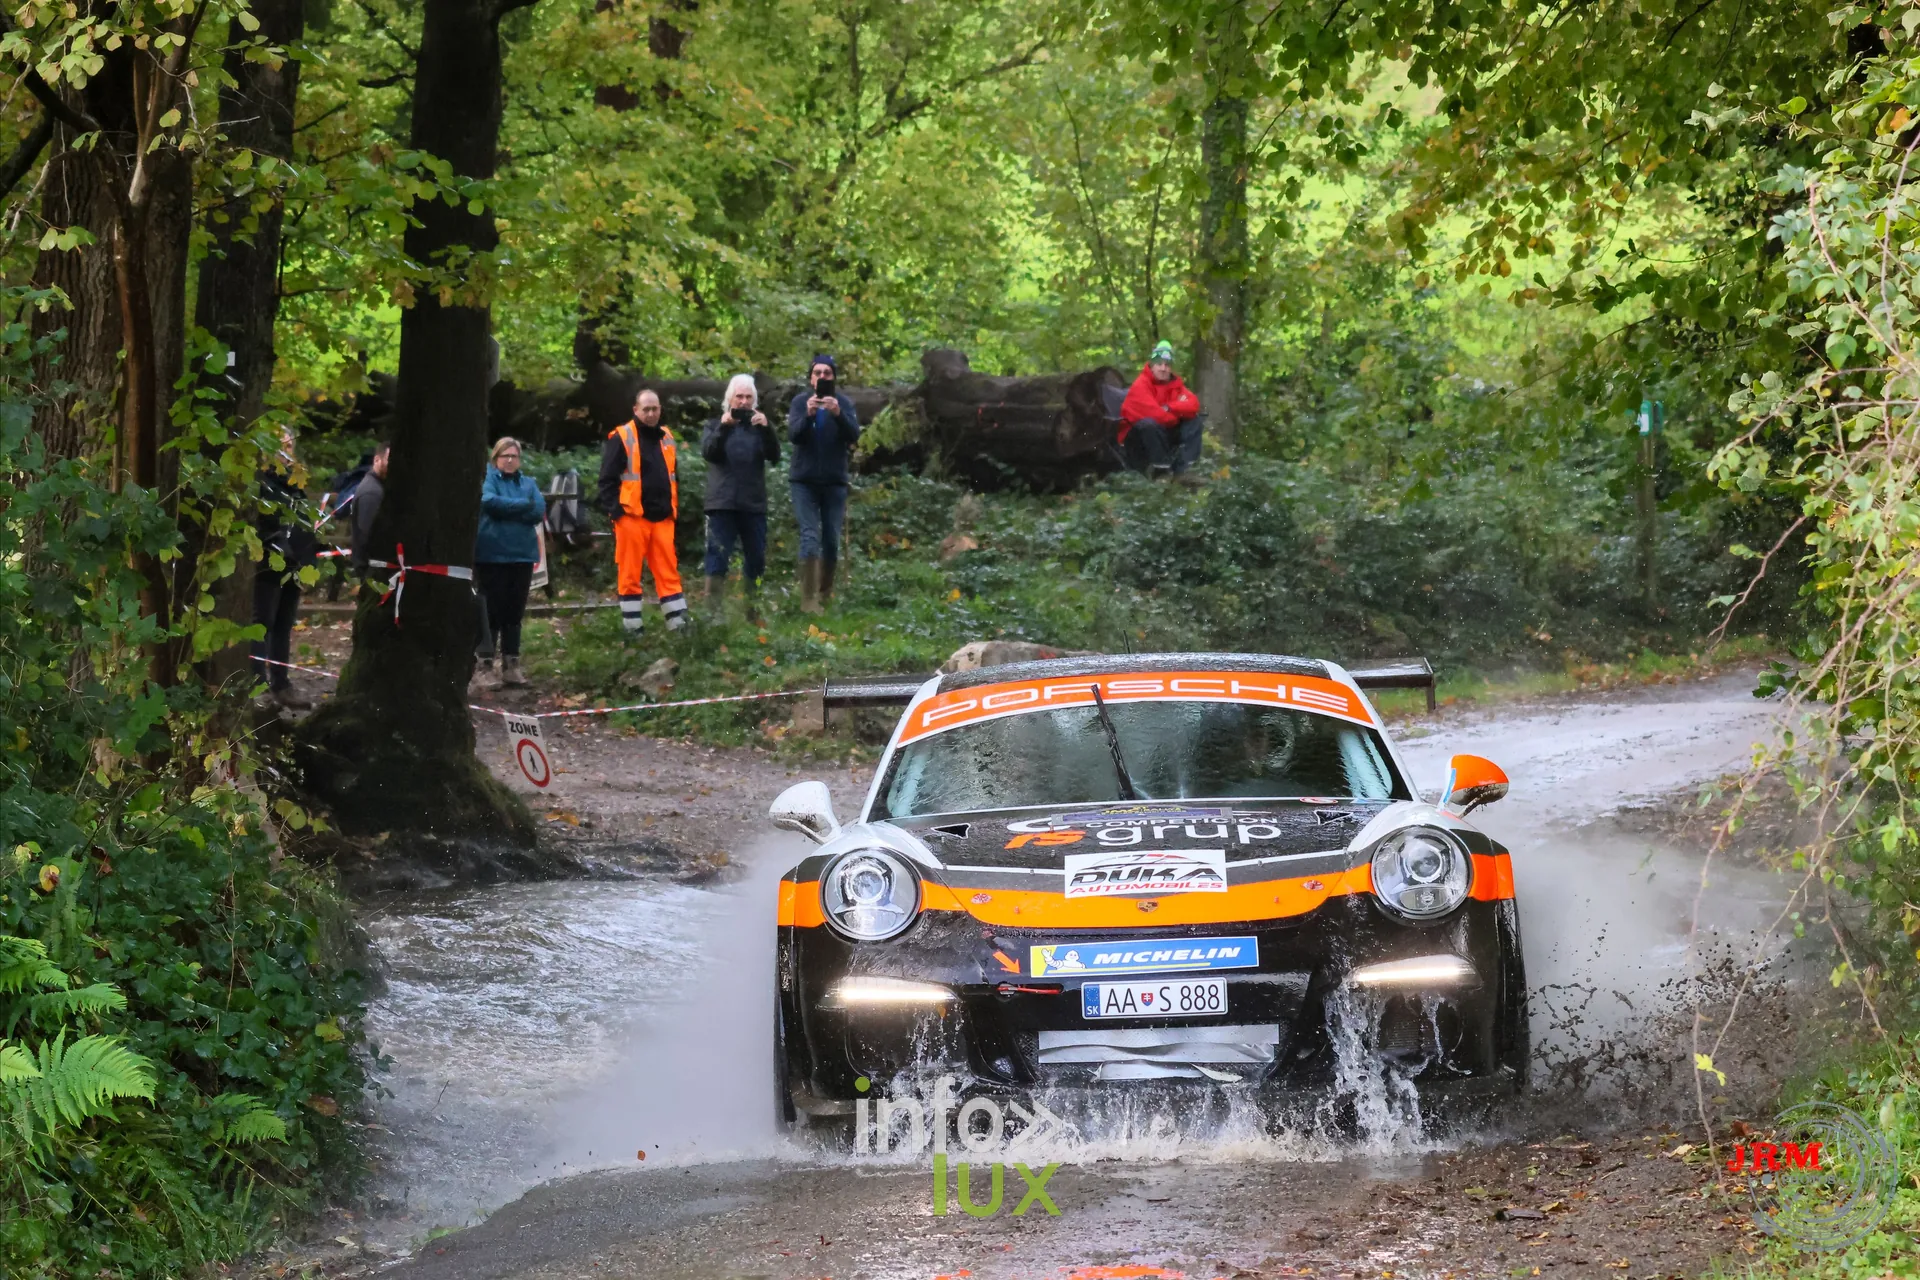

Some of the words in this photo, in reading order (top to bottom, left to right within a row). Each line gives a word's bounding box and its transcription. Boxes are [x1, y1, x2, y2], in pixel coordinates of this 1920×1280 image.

[922, 678, 1349, 727] PORSCHE
[508, 721, 539, 737] ZONE
[1096, 823, 1282, 846] grup
[1070, 867, 1224, 886] DUKA
[1092, 947, 1241, 965] MICHELIN
[1105, 987, 1138, 1014] AA
[1159, 986, 1172, 1012] S
[1180, 984, 1220, 1011] 888
[1086, 1006, 1099, 1015] SK
